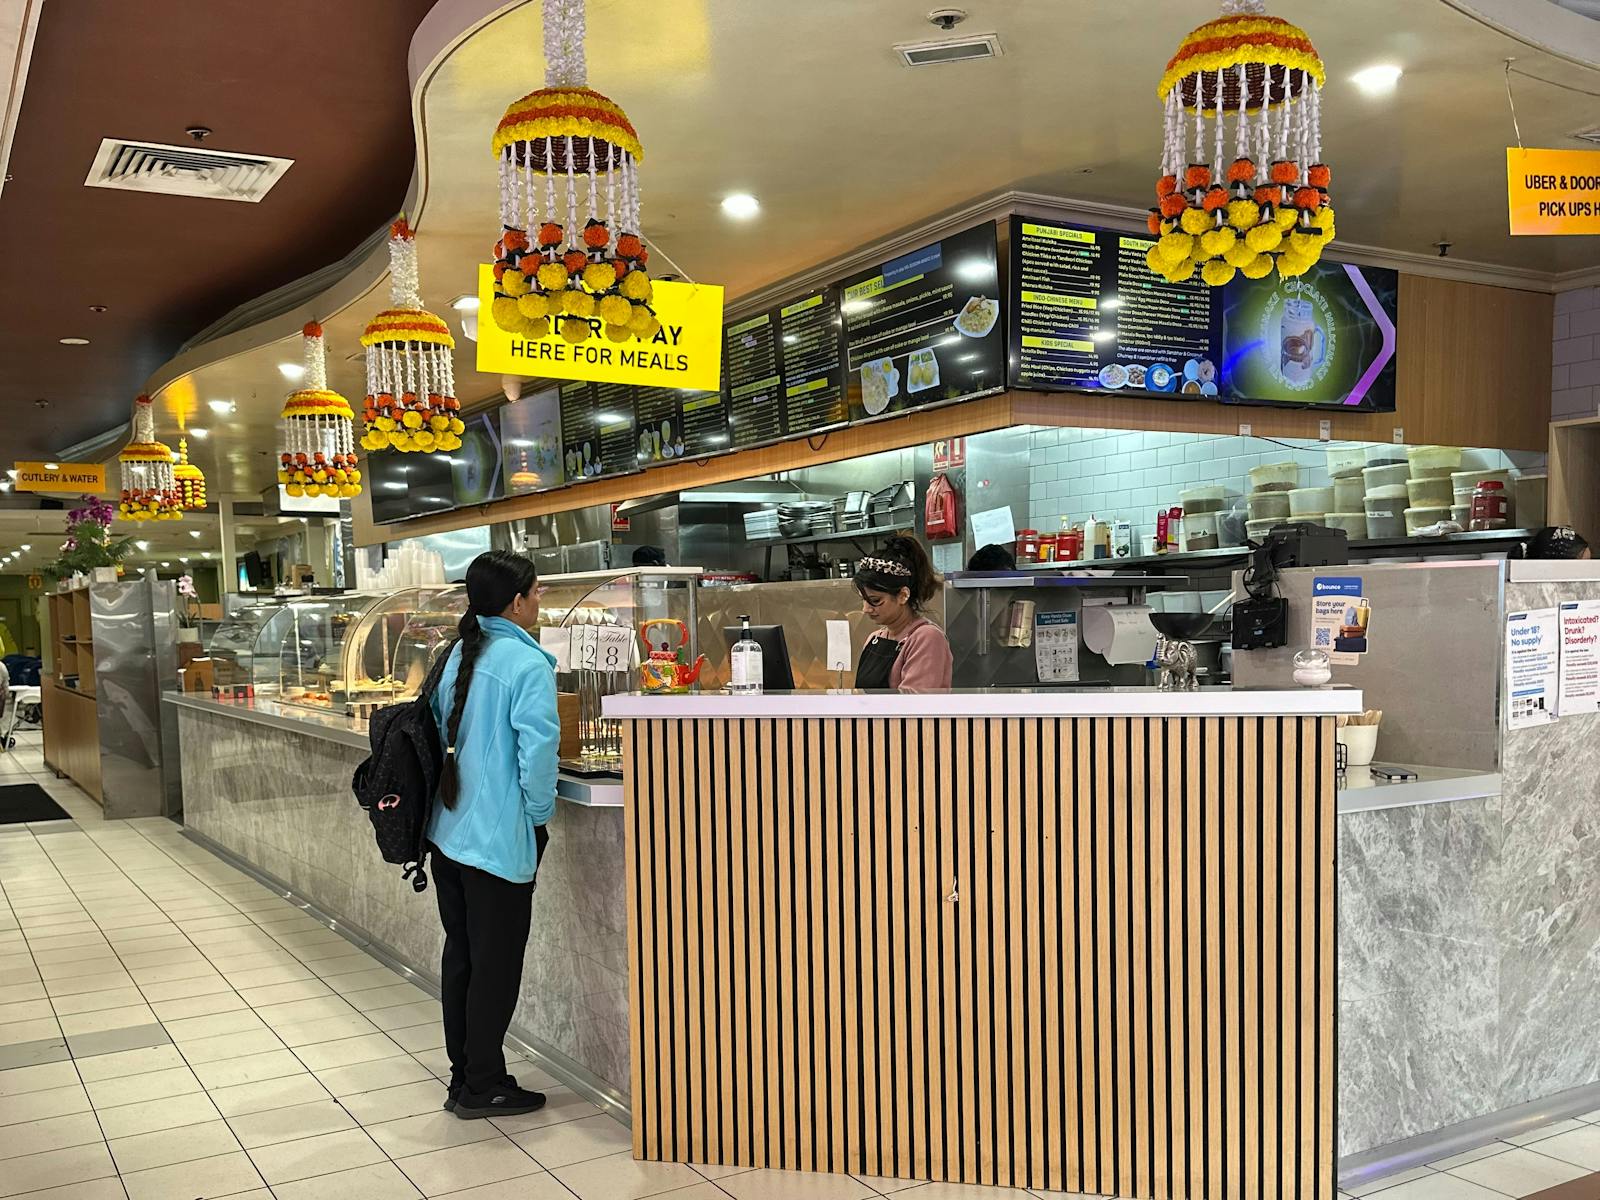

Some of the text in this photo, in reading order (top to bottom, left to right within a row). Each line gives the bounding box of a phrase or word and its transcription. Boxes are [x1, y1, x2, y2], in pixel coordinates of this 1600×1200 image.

[1525, 175, 1557, 190] UBER
[1560, 175, 1568, 190] &
[1540, 202, 1566, 216] PICK
[1569, 202, 1591, 216] UPS
[1036, 227, 1082, 239] PUNJABI SPECIALS
[860, 283, 873, 296] BEST
[1069, 298, 1083, 306] MENU
[1054, 340, 1073, 348] SPECIAL
[511, 340, 688, 371] HERE FOR MEALS
[21, 473, 98, 483] CUTLERY & WATER
[1564, 615, 1599, 625] Intoxicated?
[1511, 625, 1541, 636] Under 18?
[1565, 626, 1585, 635] Drunk?
[600, 630, 627, 644] Table
[1521, 635, 1543, 646] supply
[1565, 635, 1598, 645] Disorderly?
[605, 646, 618, 666] 8
